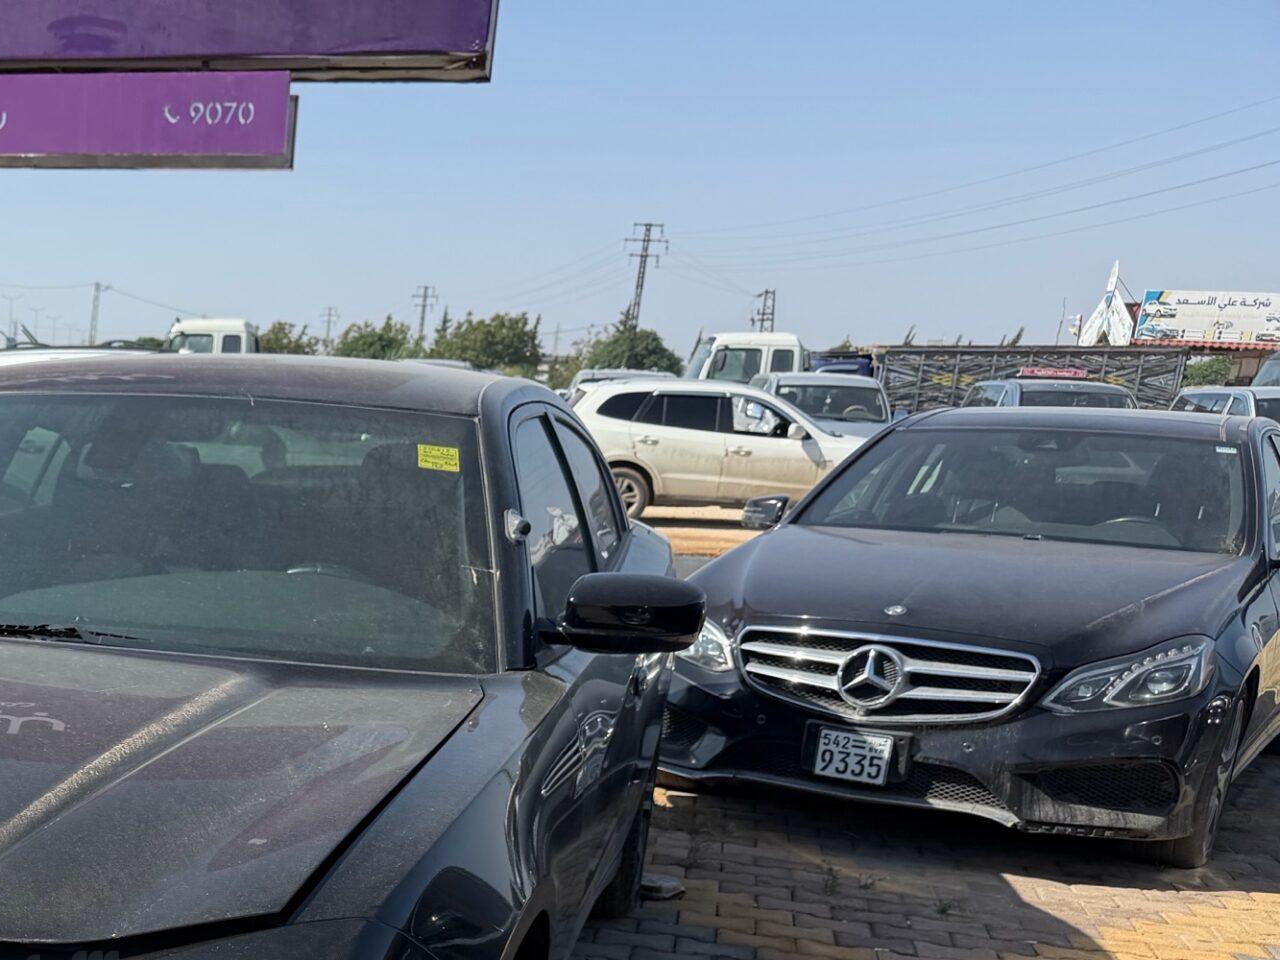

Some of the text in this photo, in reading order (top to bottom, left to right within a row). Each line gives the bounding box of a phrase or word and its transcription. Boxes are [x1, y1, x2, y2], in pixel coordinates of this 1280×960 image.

[189, 102, 255, 125] 9070
[1217, 296, 1238, 311] علي
[1240, 298, 1272, 310] شركة
[822, 733, 851, 750] 542
[820, 749, 883, 779] 9335
